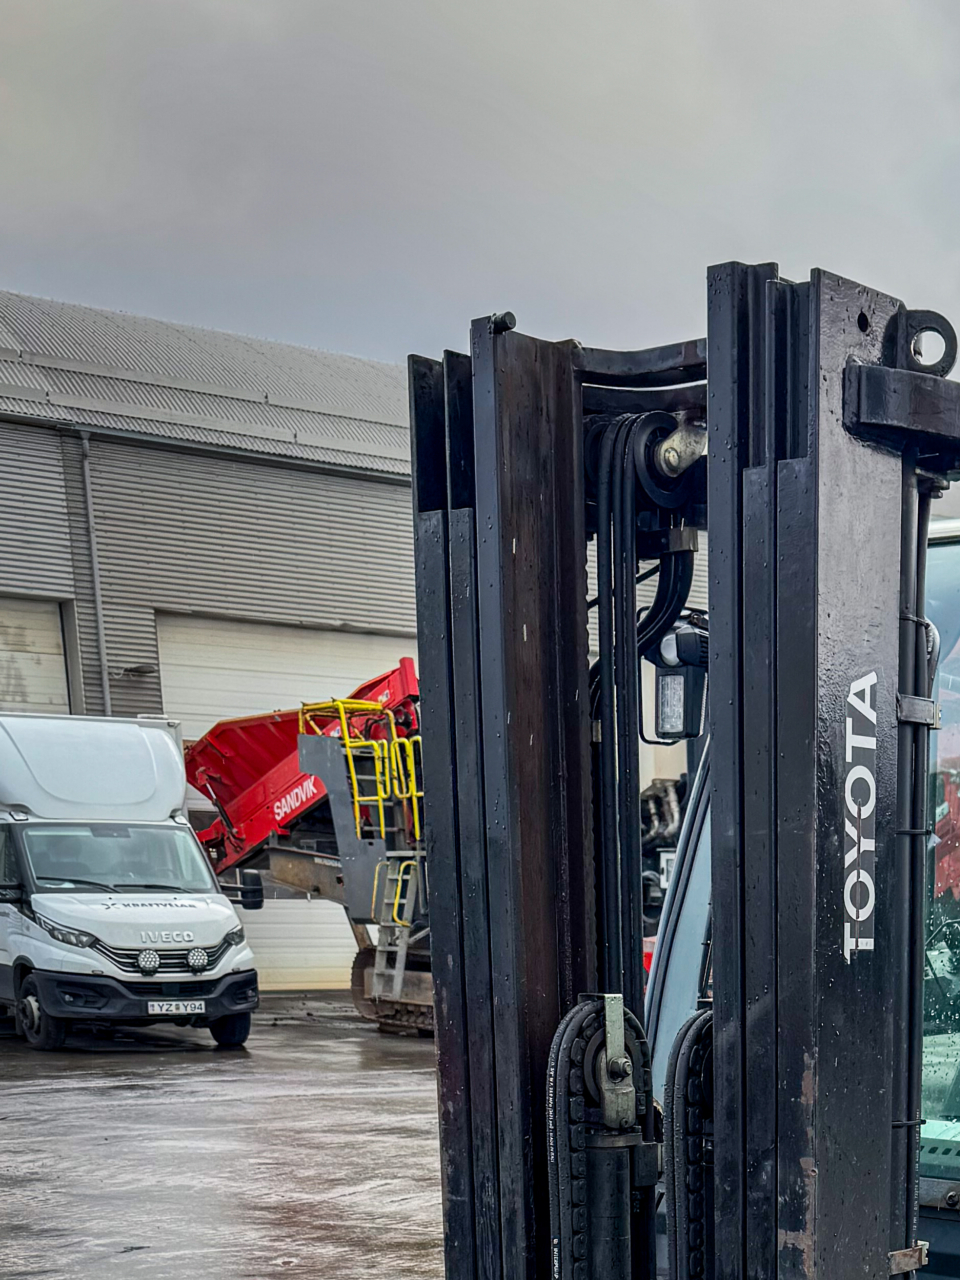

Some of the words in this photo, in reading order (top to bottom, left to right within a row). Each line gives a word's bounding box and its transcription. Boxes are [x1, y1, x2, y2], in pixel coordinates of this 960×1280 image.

[274, 775, 317, 820] SANDVIK
[843, 671, 878, 965] TOYOTA
[141, 931, 194, 943] IVECO
[158, 1003, 173, 1012] YZ
[182, 1003, 204, 1012] Y94
